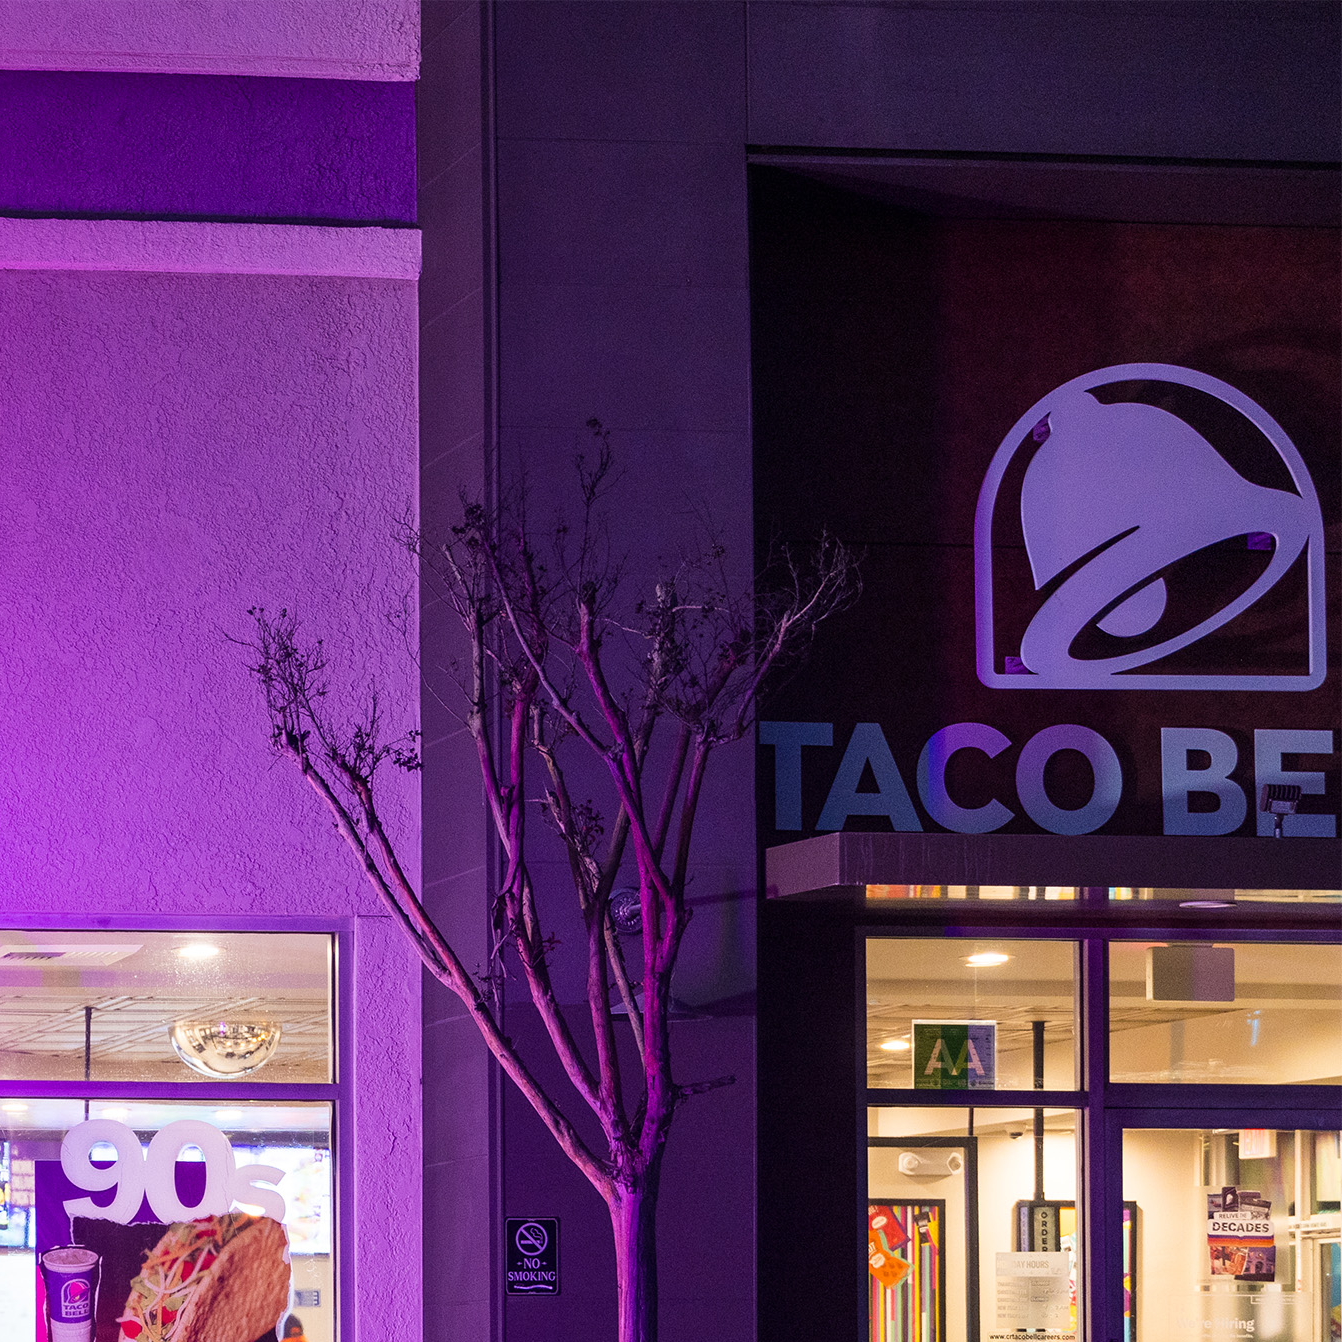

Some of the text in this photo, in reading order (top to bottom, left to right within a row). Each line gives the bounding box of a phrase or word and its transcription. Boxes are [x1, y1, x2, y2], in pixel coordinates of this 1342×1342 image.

[759, 721, 1123, 836] TACO
[61, 1118, 286, 1224] 90s
[1212, 1222, 1269, 1233] DECADES
[523, 1258, 541, 1270] NO
[508, 1271, 556, 1281] SMOKING
[63, 1303, 88, 1311] TACO
[64, 1309, 88, 1317] BELL
[989, 1333, 1076, 1342] www.crtacobellcareers.com
